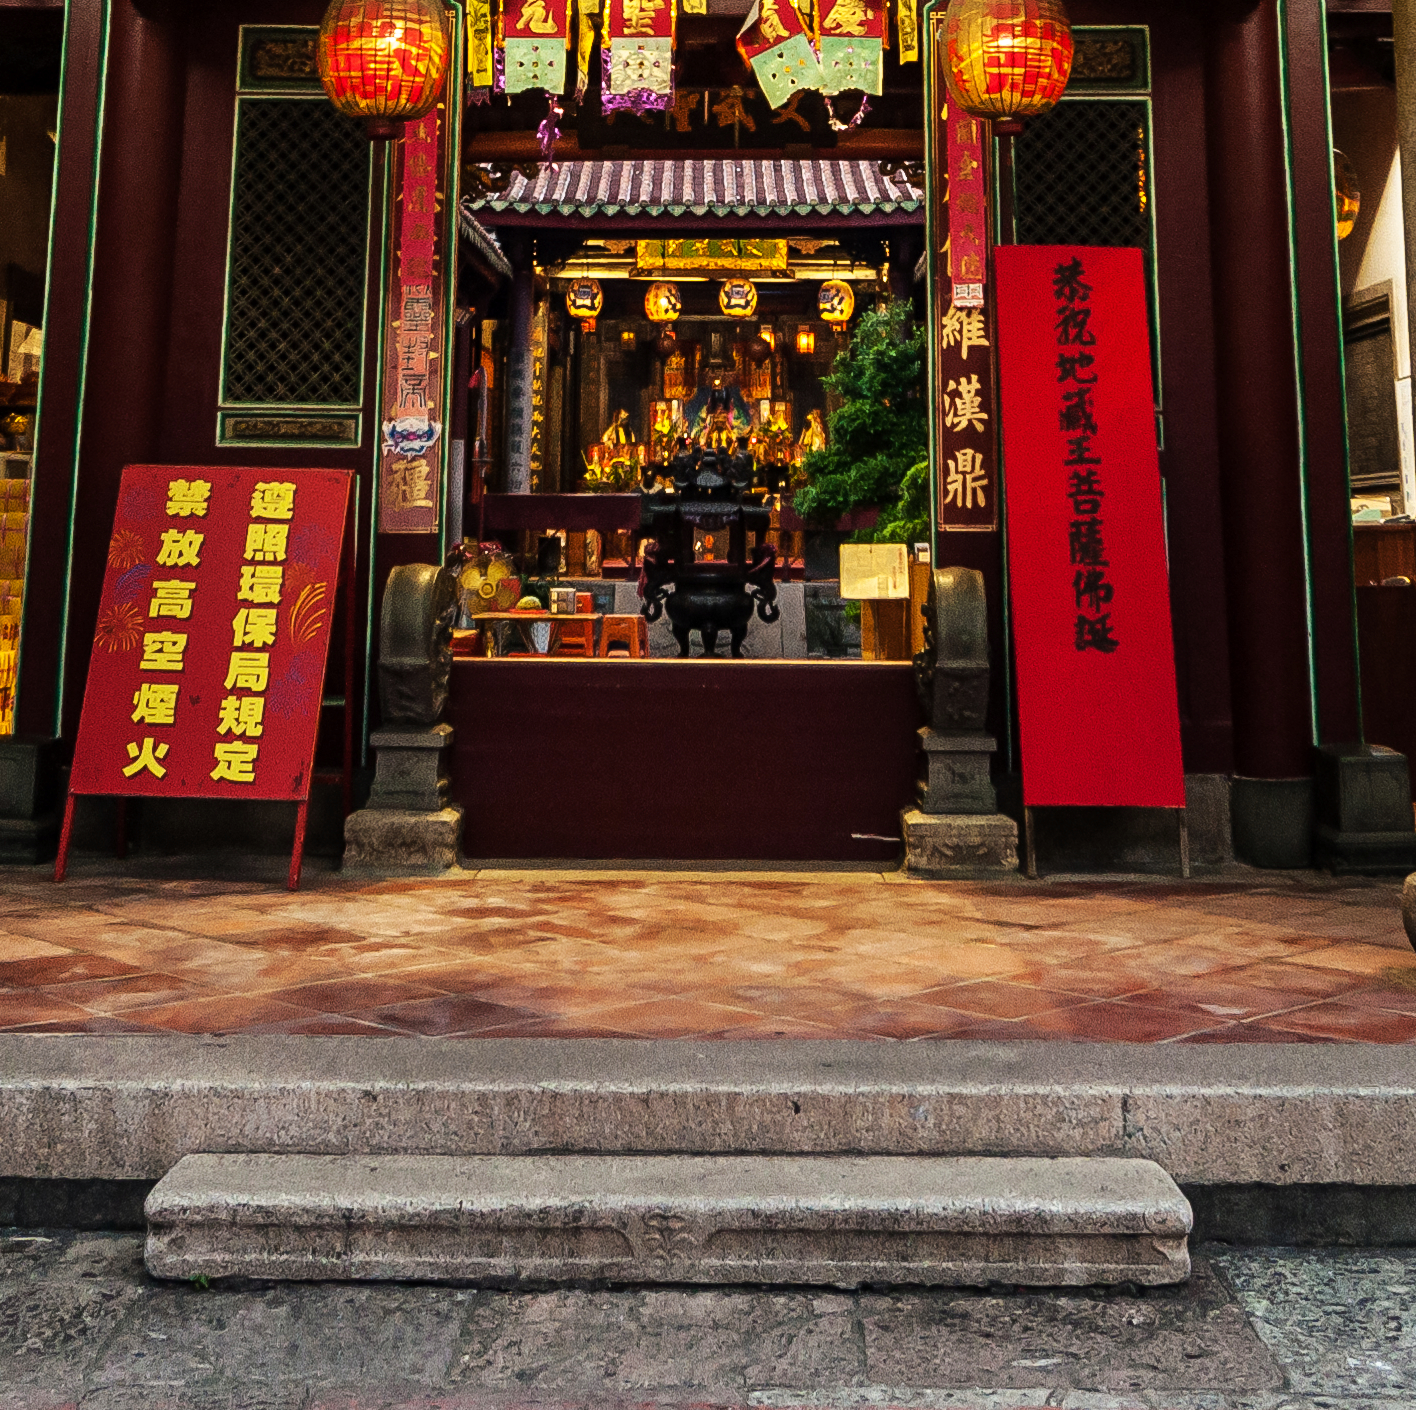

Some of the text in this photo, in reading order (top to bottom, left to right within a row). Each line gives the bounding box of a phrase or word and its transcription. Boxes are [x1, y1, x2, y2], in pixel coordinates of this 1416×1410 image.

[1051, 255, 1121, 655] 恭祝地藏王菩薩佛誕
[121, 478, 213, 780] 禁放高空煙火
[209, 480, 297, 784] 遵照環保局規定
